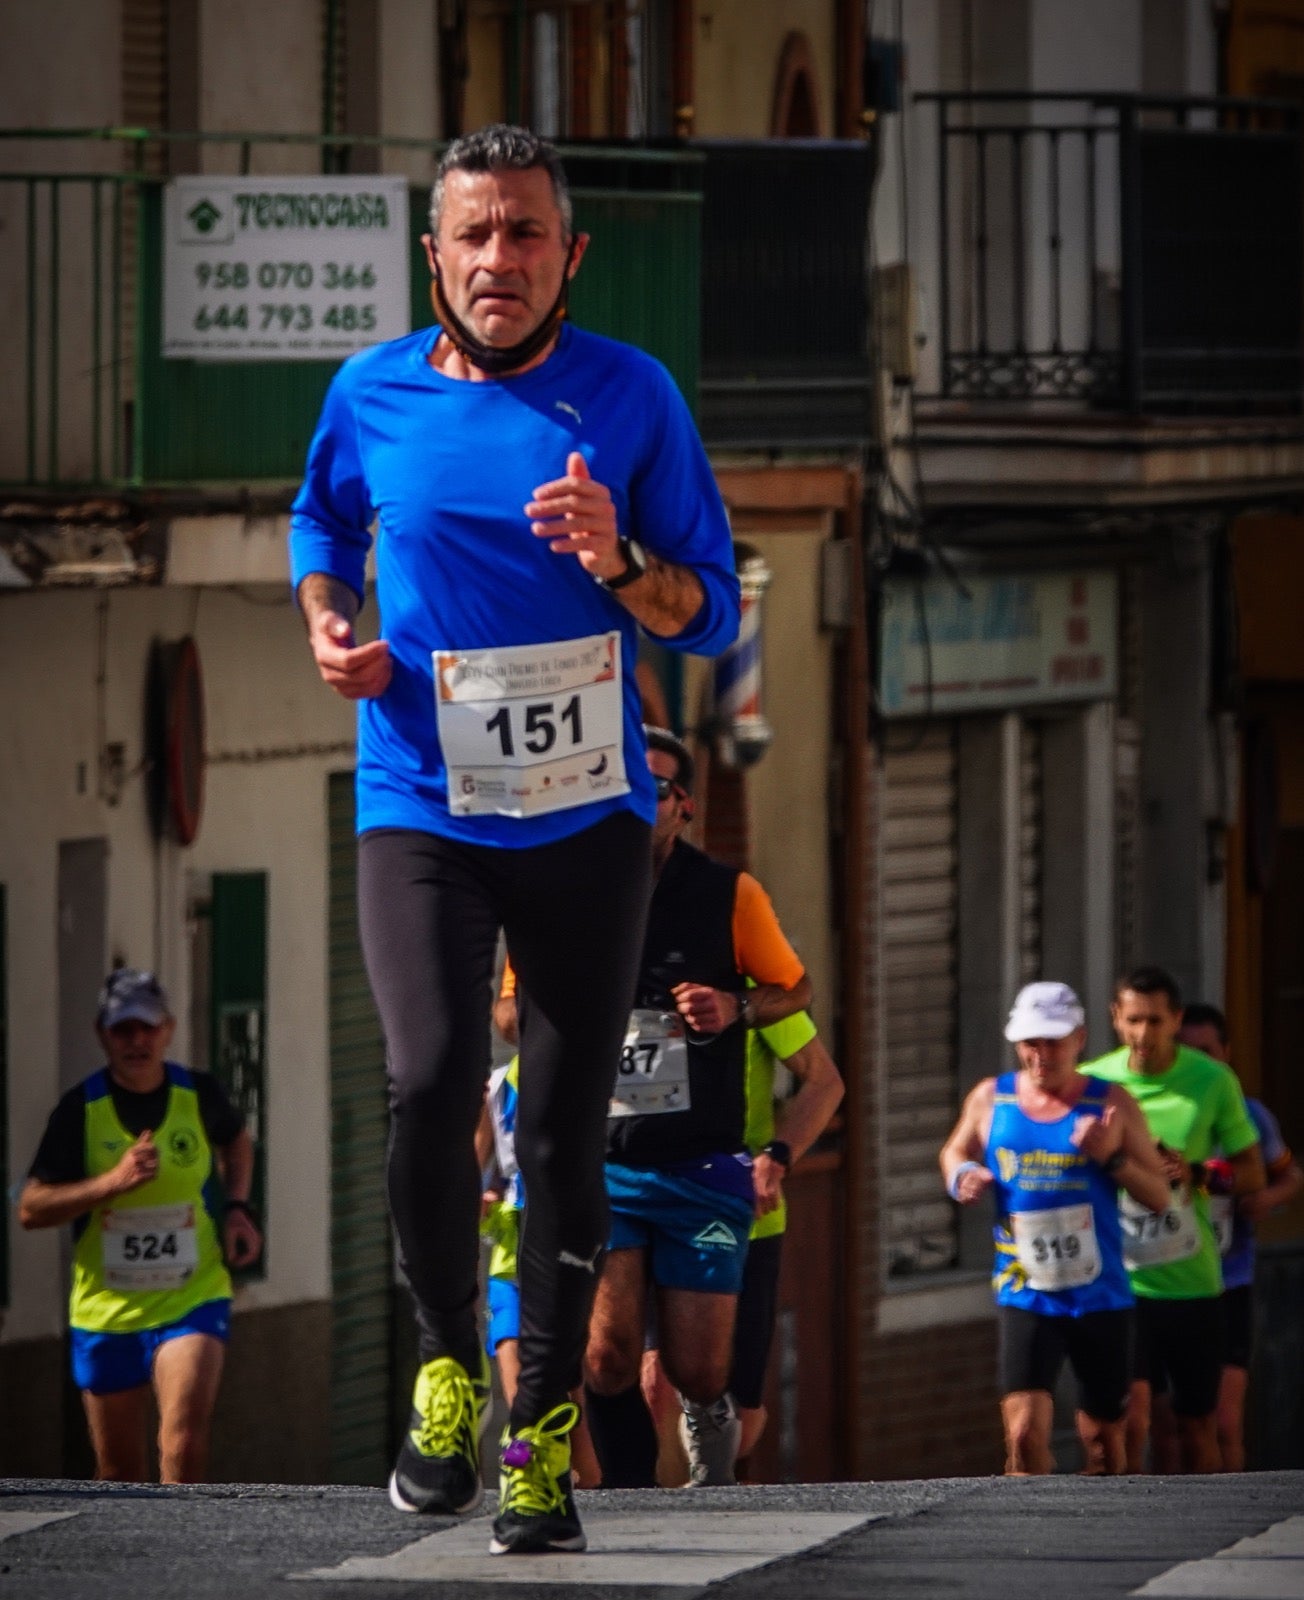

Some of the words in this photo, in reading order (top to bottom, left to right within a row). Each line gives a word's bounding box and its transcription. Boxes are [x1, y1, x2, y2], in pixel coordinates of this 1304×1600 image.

[233, 193, 389, 229] TECNOCASA
[195, 261, 249, 290] 958
[257, 261, 314, 290] 070
[321, 261, 376, 290] 366
[194, 304, 248, 331] 644
[259, 304, 313, 331] 793
[322, 304, 376, 331] 485
[486, 695, 582, 757] 151
[124, 1234, 177, 1260] 524
